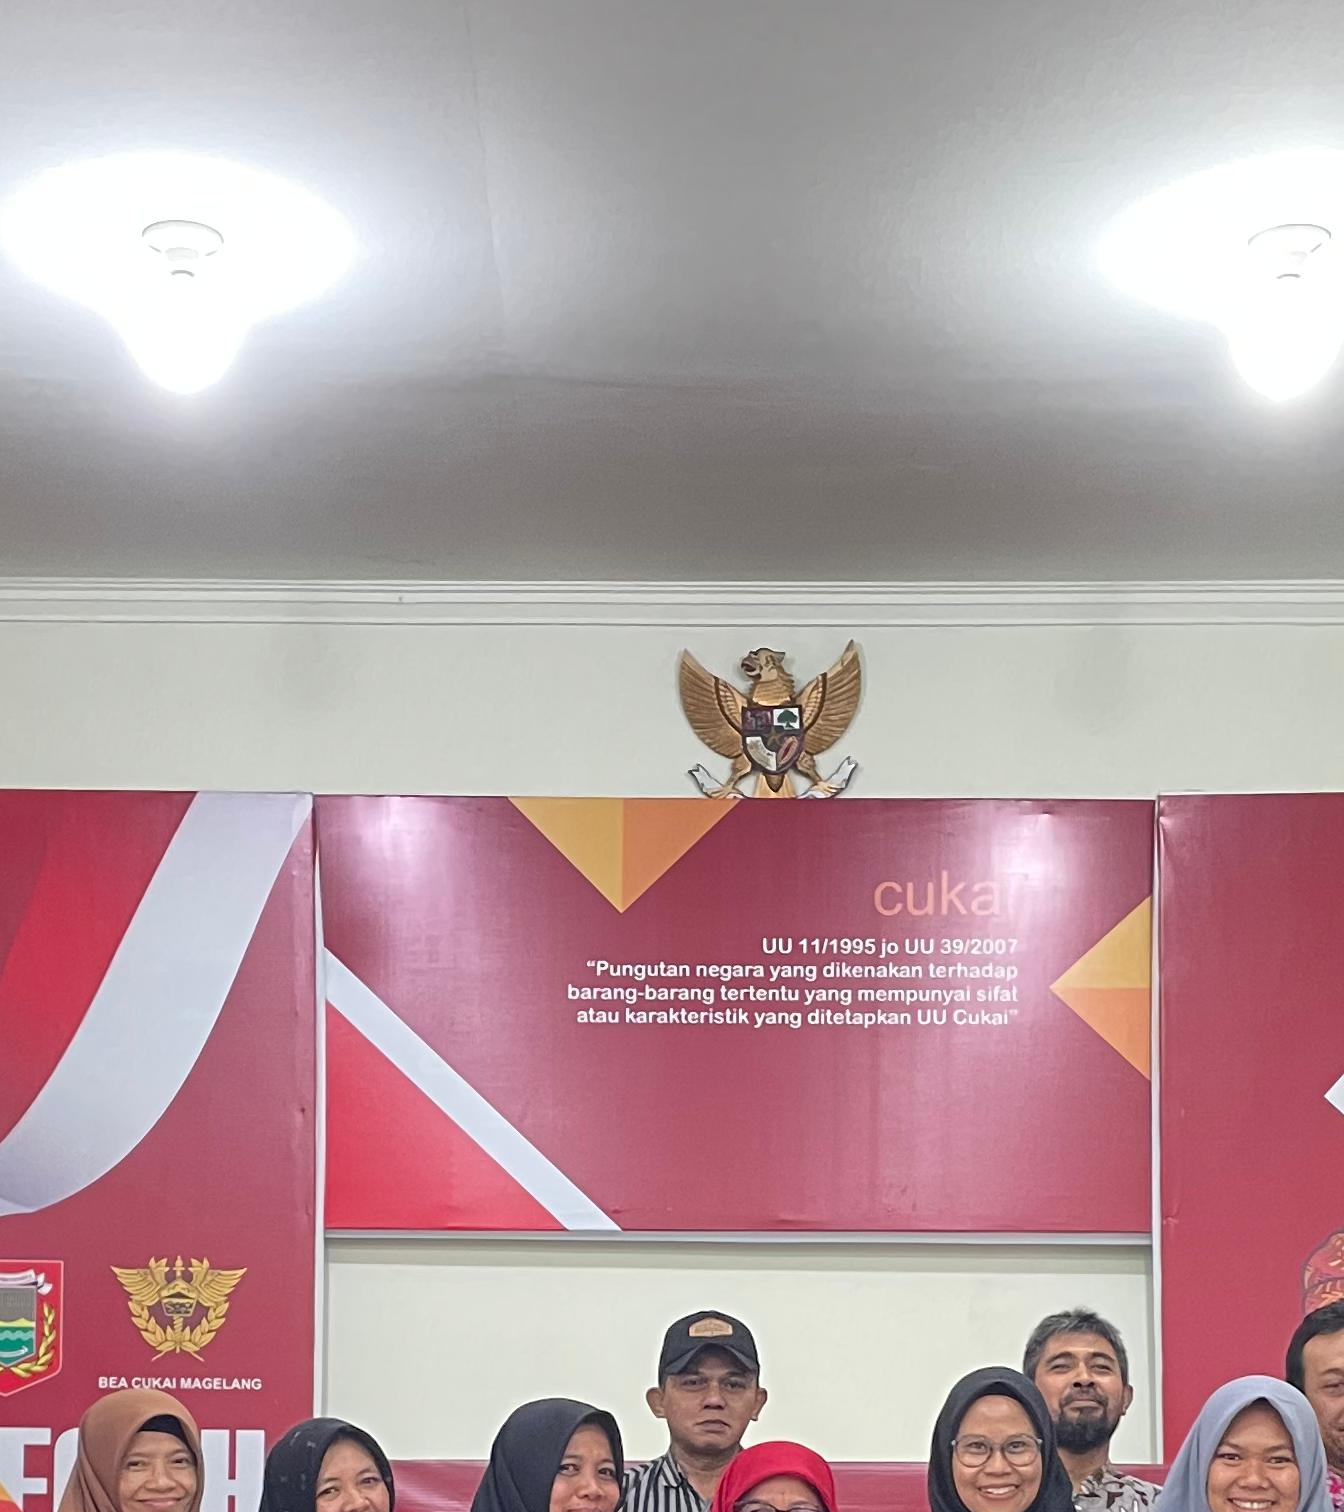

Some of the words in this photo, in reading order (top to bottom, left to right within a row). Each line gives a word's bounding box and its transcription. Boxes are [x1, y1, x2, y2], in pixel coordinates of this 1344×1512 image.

[762, 937, 793, 955] UU
[799, 937, 876, 955] 11/1995
[880, 938, 899, 959] jo
[904, 937, 935, 955] UU
[940, 937, 1018, 955] 39/2007
[586, 959, 691, 981] “Pungutan
[695, 964, 765, 982] negara
[769, 965, 817, 982] yang
[822, 961, 923, 979] dikenakan
[928, 962, 1018, 981] terhadap
[567, 984, 715, 1004] barang-barang
[719, 984, 800, 1002] tertentu
[803, 988, 852, 1006] yang
[857, 985, 971, 1005] mempunyai
[976, 985, 1018, 1002] sifat
[576, 1007, 620, 1024] atau
[625, 1007, 750, 1025] karakteristik
[753, 1011, 802, 1029] yang
[807, 1008, 912, 1029] ditetapkan
[917, 1008, 947, 1025] UU
[98, 1376, 129, 1390] BEA
[131, 1376, 177, 1391] CUKAI
[180, 1377, 263, 1392] MAGELANG
